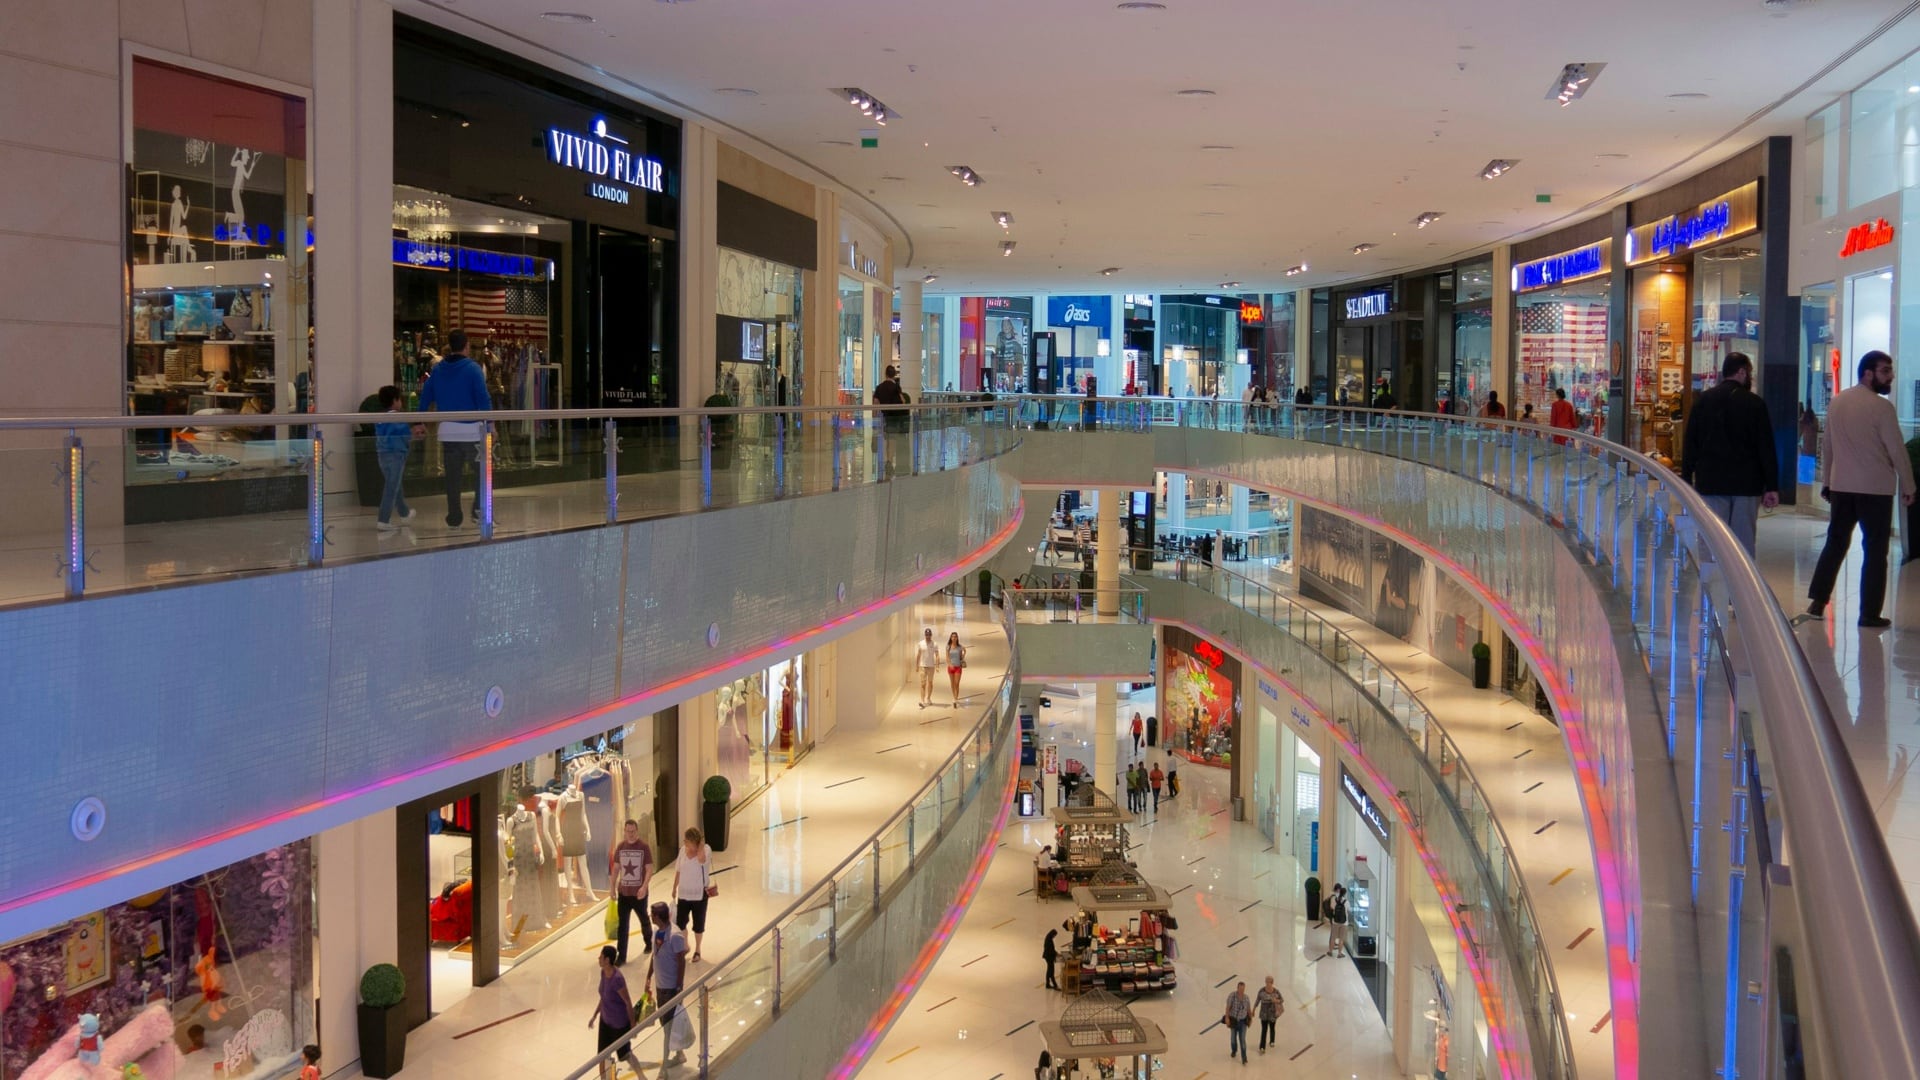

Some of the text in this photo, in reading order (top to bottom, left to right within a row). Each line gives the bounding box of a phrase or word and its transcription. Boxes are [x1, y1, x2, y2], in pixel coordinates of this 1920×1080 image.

[551, 129, 663, 193] VIVID FLAIR
[592, 182, 629, 205] LONDON
[1345, 293, 1386, 320] STADIUM
[605, 390, 647, 399] VIVID FLAIR
